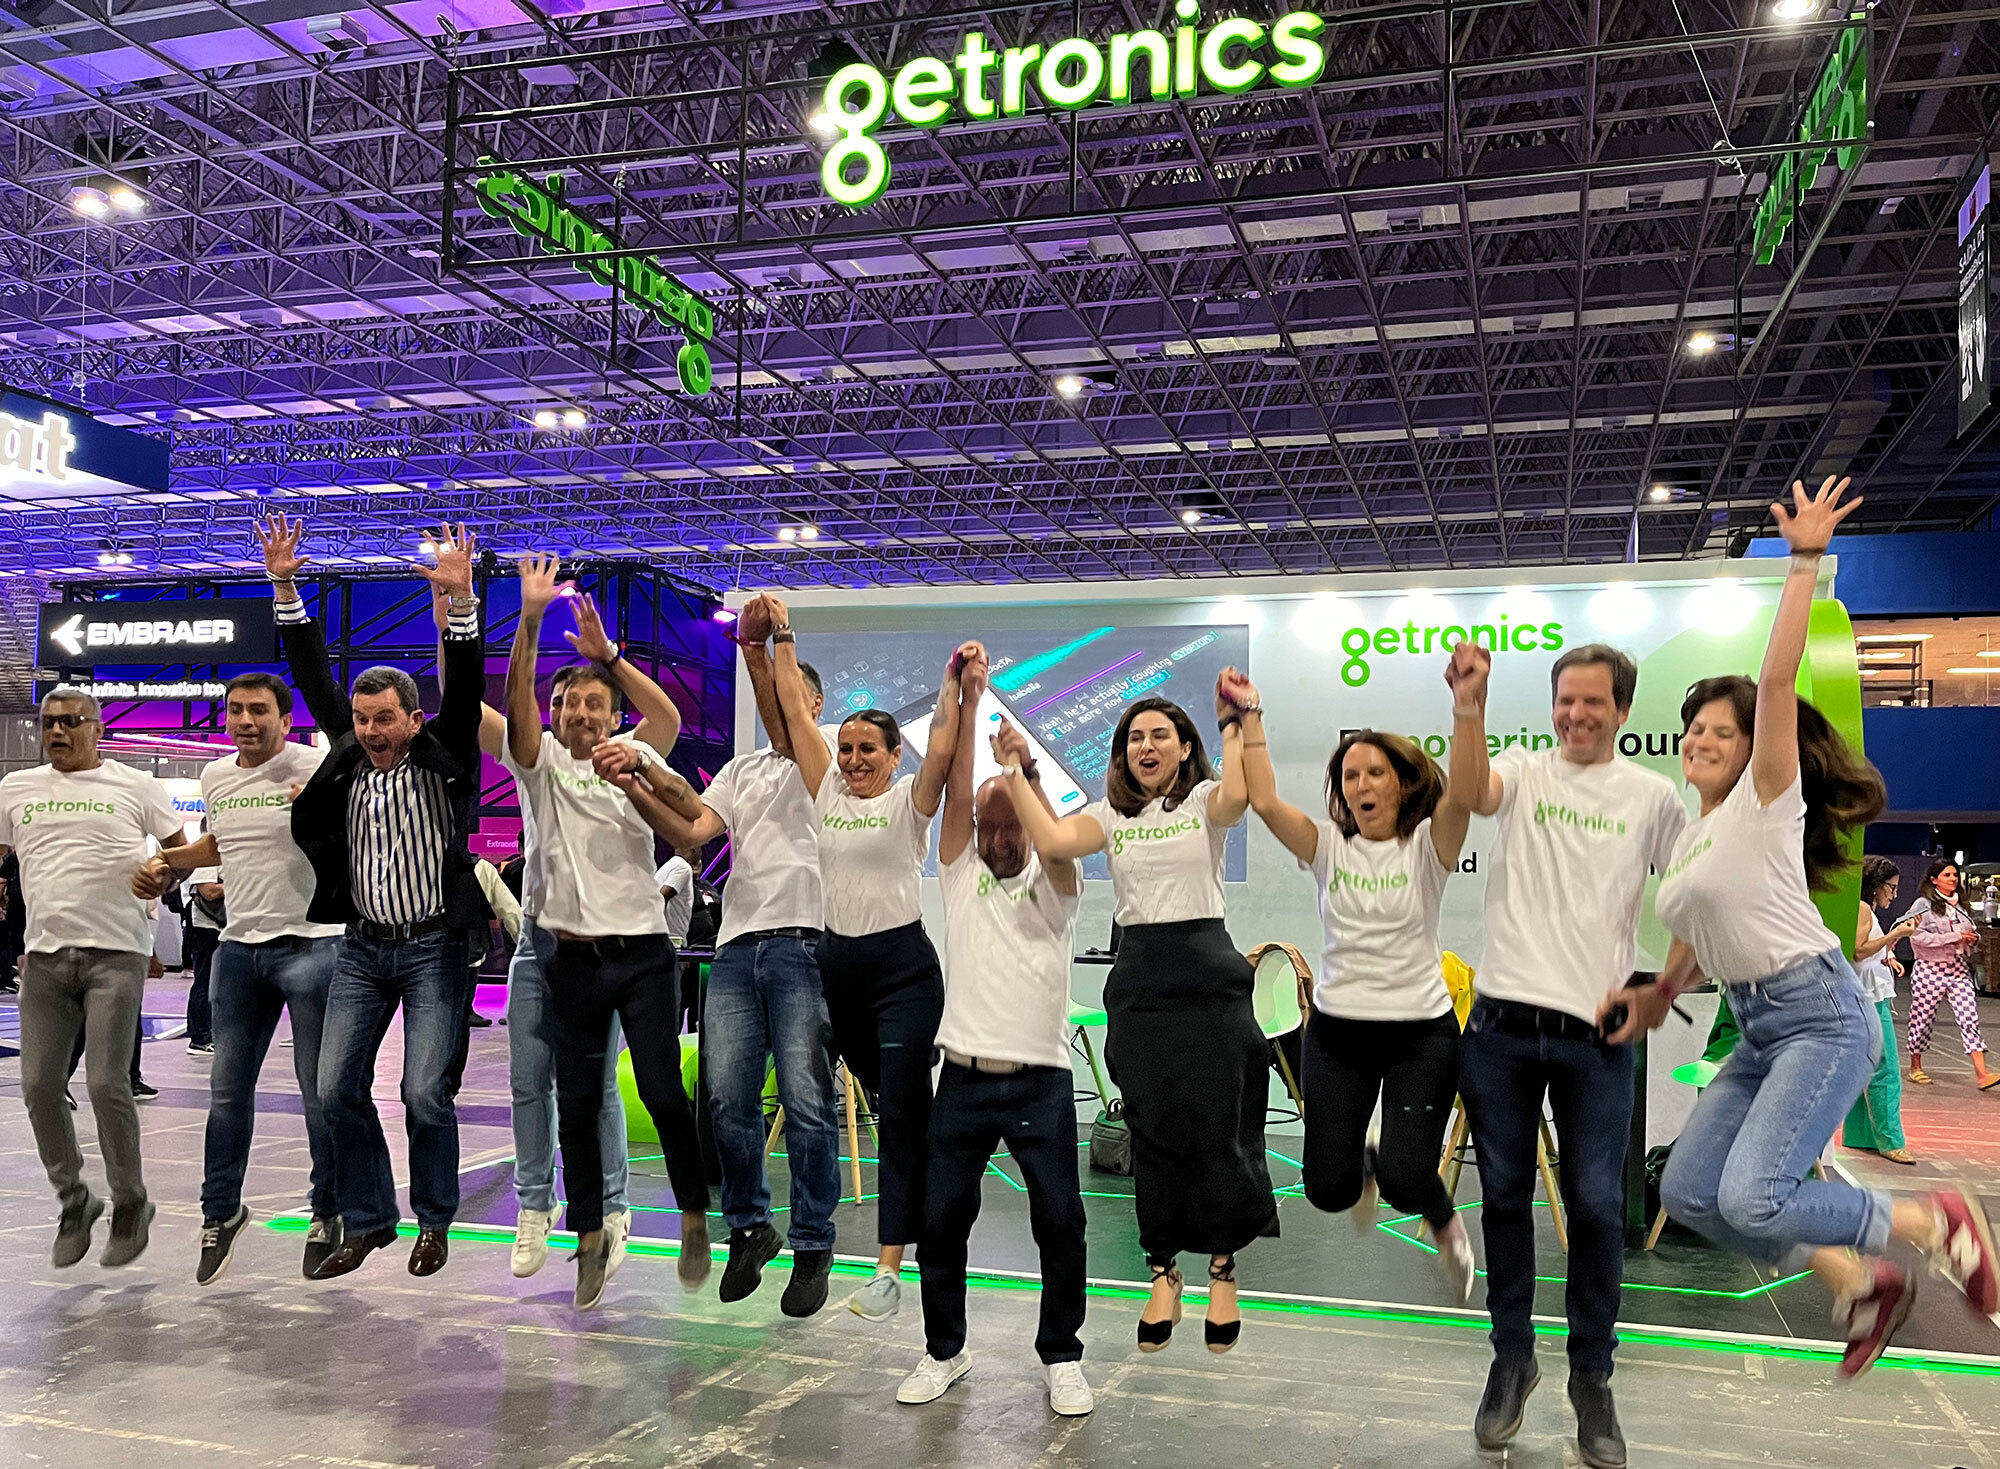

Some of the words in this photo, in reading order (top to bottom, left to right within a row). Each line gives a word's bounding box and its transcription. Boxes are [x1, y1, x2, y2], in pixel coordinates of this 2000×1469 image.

[822, 0, 1326, 206] getronics
[86, 618, 235, 646] EMBRAER
[1341, 613, 1564, 687] getronics
[1007, 682, 1041, 702] Isabella
[1038, 714, 1064, 732] Yeah
[1064, 703, 1088, 719] he's
[1090, 680, 1129, 706] actually
[1078, 707, 1103, 724] more
[21, 798, 115, 825] getronics
[1113, 818, 1202, 855] getronics
